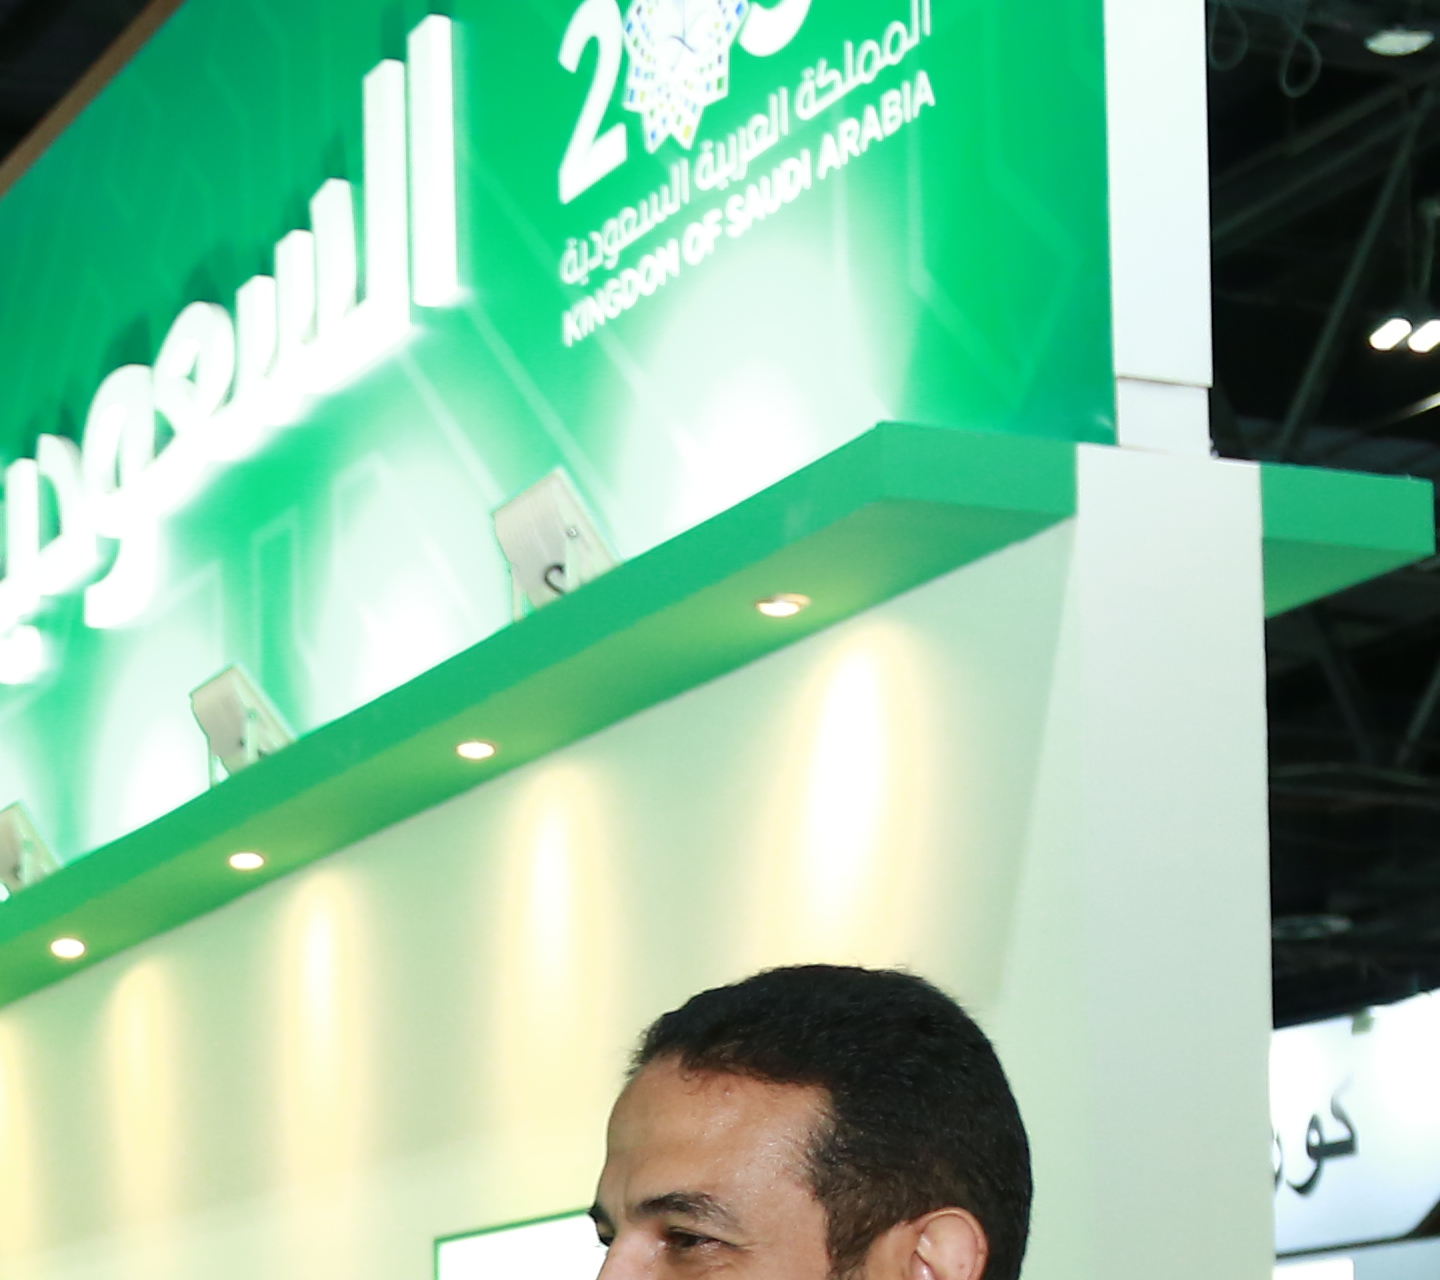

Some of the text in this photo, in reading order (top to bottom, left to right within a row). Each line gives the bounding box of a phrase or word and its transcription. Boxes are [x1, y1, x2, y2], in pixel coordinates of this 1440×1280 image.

[559, 157, 690, 286] السعودية
[681, 208, 723, 266] OF
[725, 149, 812, 238] SAUDI
[816, 69, 936, 180] ARABIA
